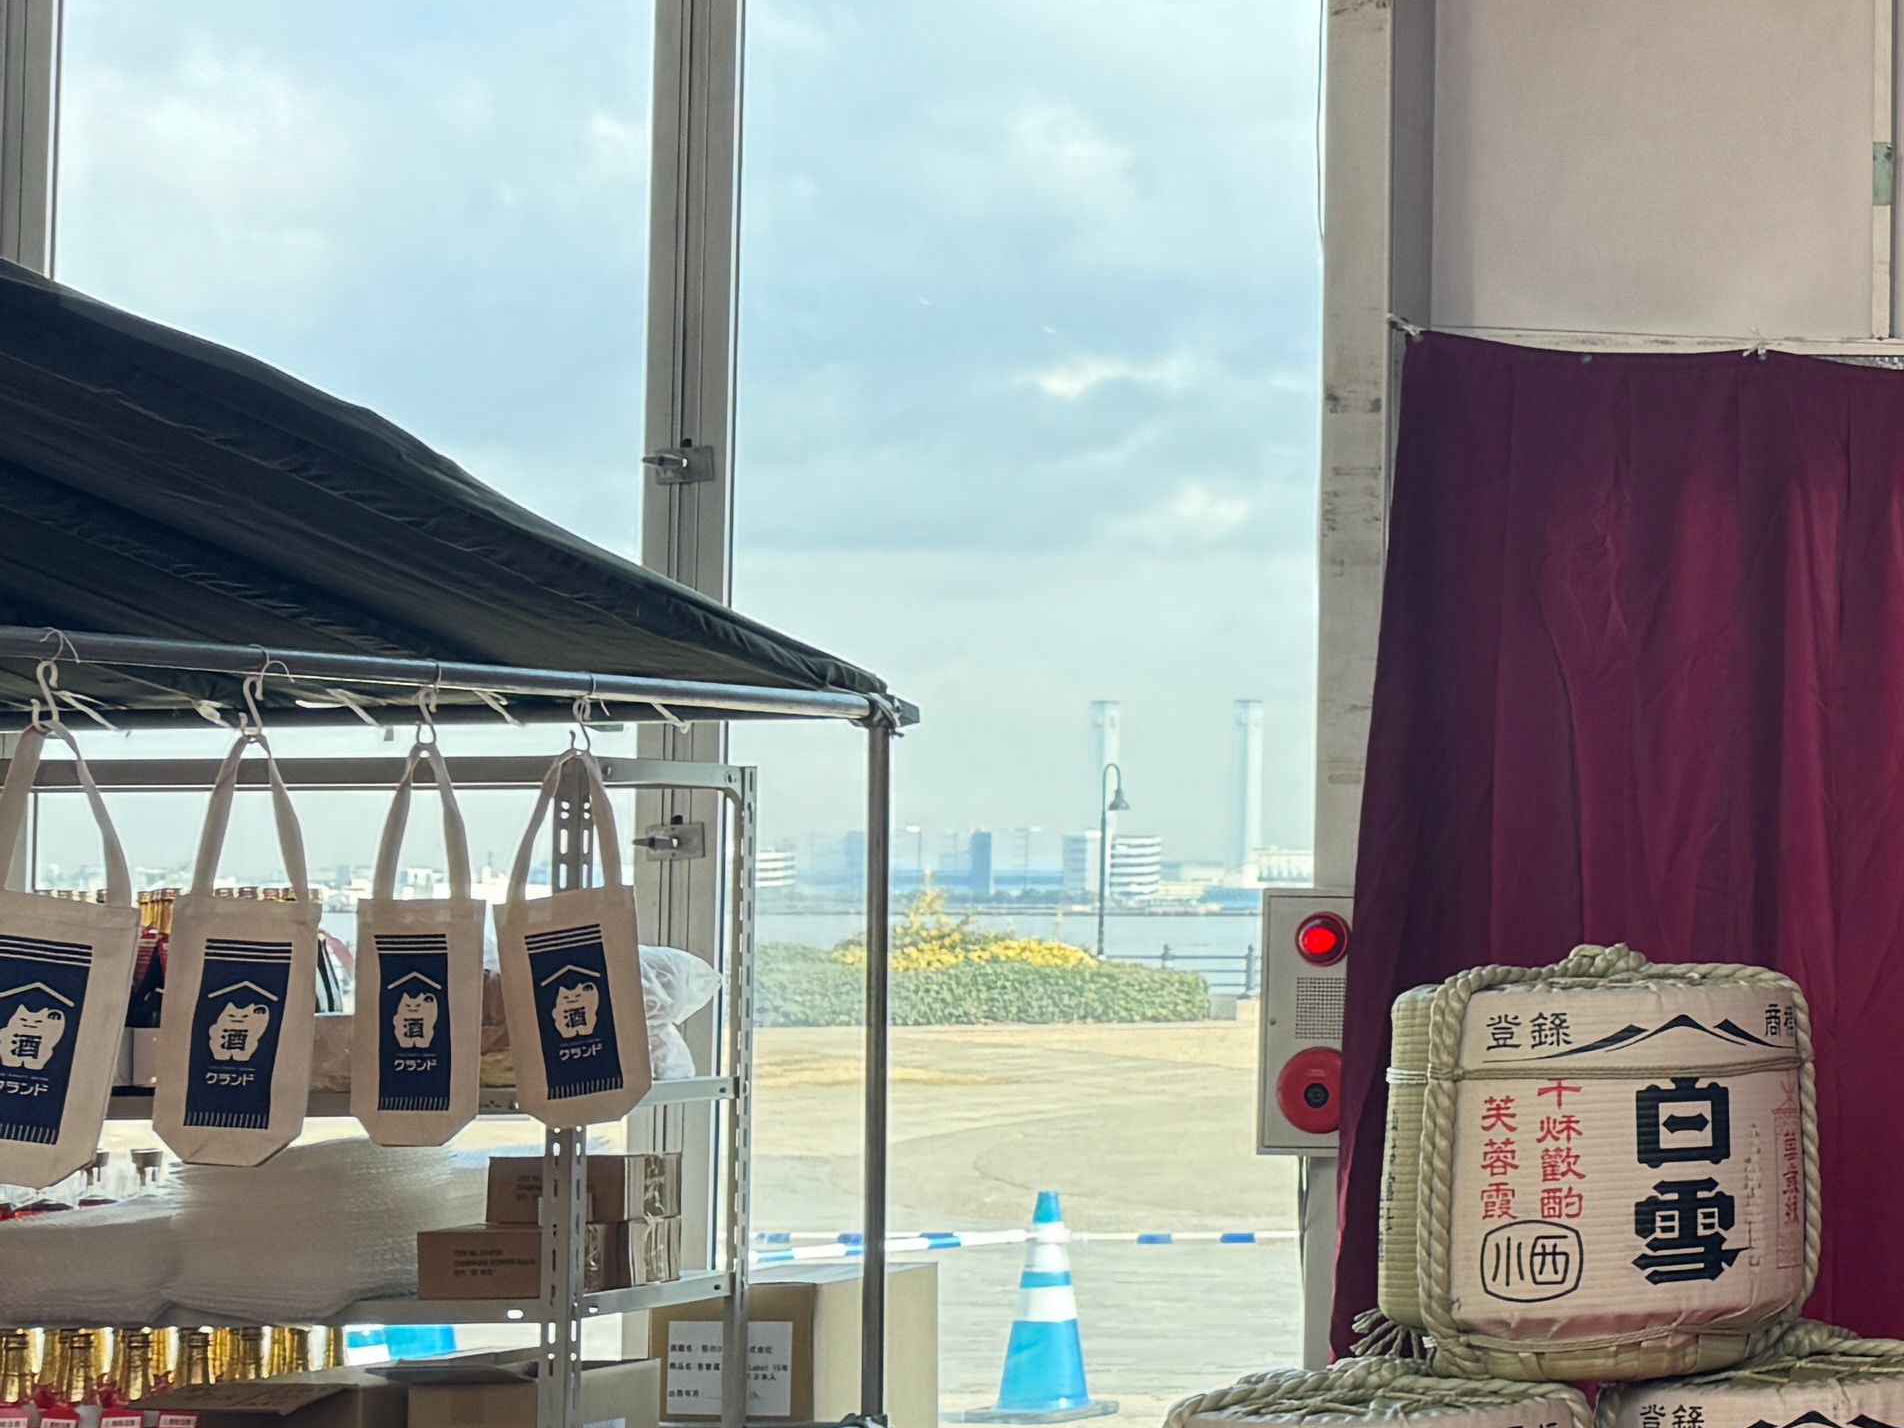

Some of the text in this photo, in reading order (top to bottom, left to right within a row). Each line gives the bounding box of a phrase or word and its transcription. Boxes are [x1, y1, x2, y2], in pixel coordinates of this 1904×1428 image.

[404, 1018, 424, 1039] 酒
[564, 1007, 586, 1029] 酒
[10, 1034, 42, 1059] 酒
[221, 1029, 248, 1052] 酒
[559, 1043, 603, 1061] クランド
[394, 1059, 437, 1071] クランド
[206, 1072, 255, 1086] クランド
[1632, 1077, 1755, 1285] 白雪
